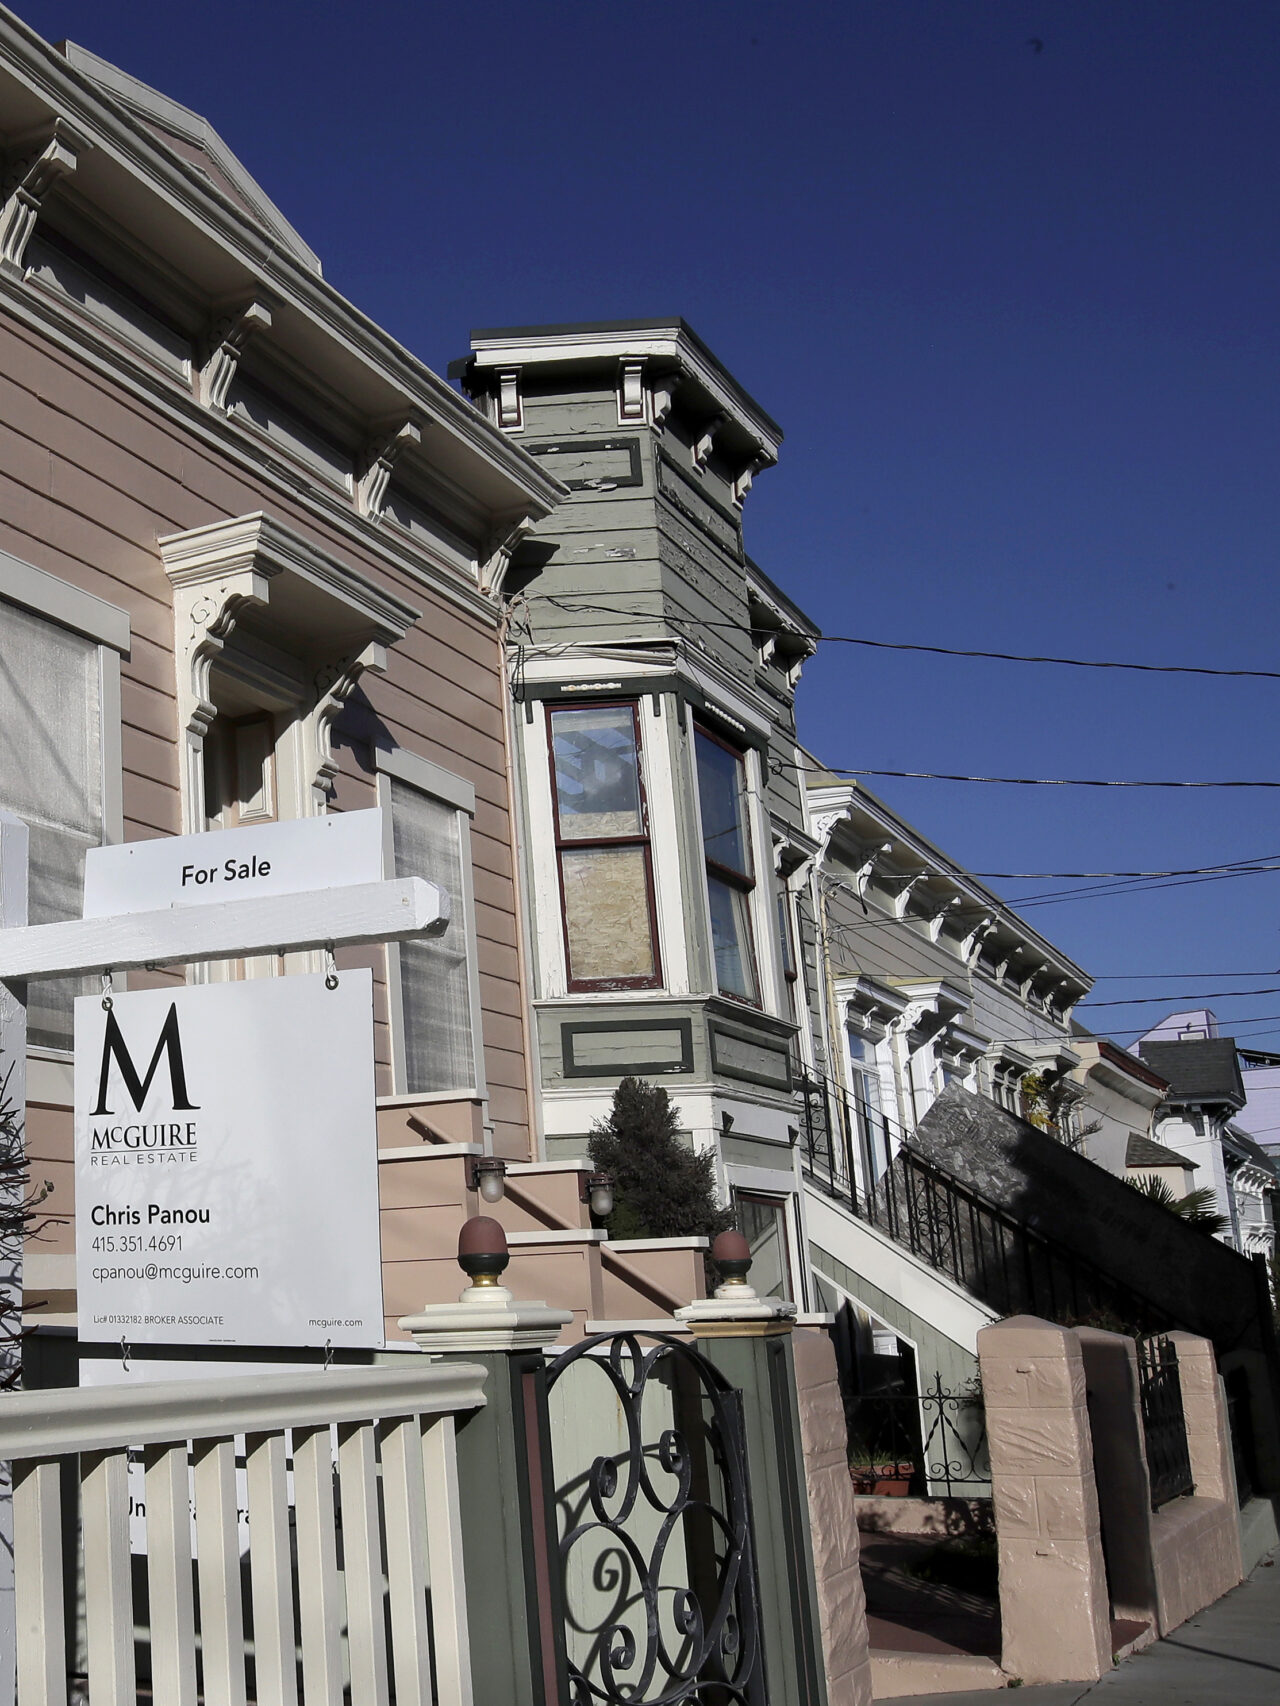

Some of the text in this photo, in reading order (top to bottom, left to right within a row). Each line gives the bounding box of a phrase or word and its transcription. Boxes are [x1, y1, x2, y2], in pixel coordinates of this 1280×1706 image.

[181, 855, 271, 887] For Sale
[89, 1001, 201, 1116] M
[90, 1151, 198, 1166] REAL ESTATE
[91, 1203, 210, 1226] Chris Panou
[91, 1234, 183, 1252] 415.351.4691
[92, 1262, 259, 1284] cpanou@mcguire.com
[108, 1314, 143, 1325] 01332182
[144, 1315, 176, 1325] BROKER
[177, 1315, 224, 1326] ASSOCIATE
[308, 1317, 363, 1329] mcguire.com
